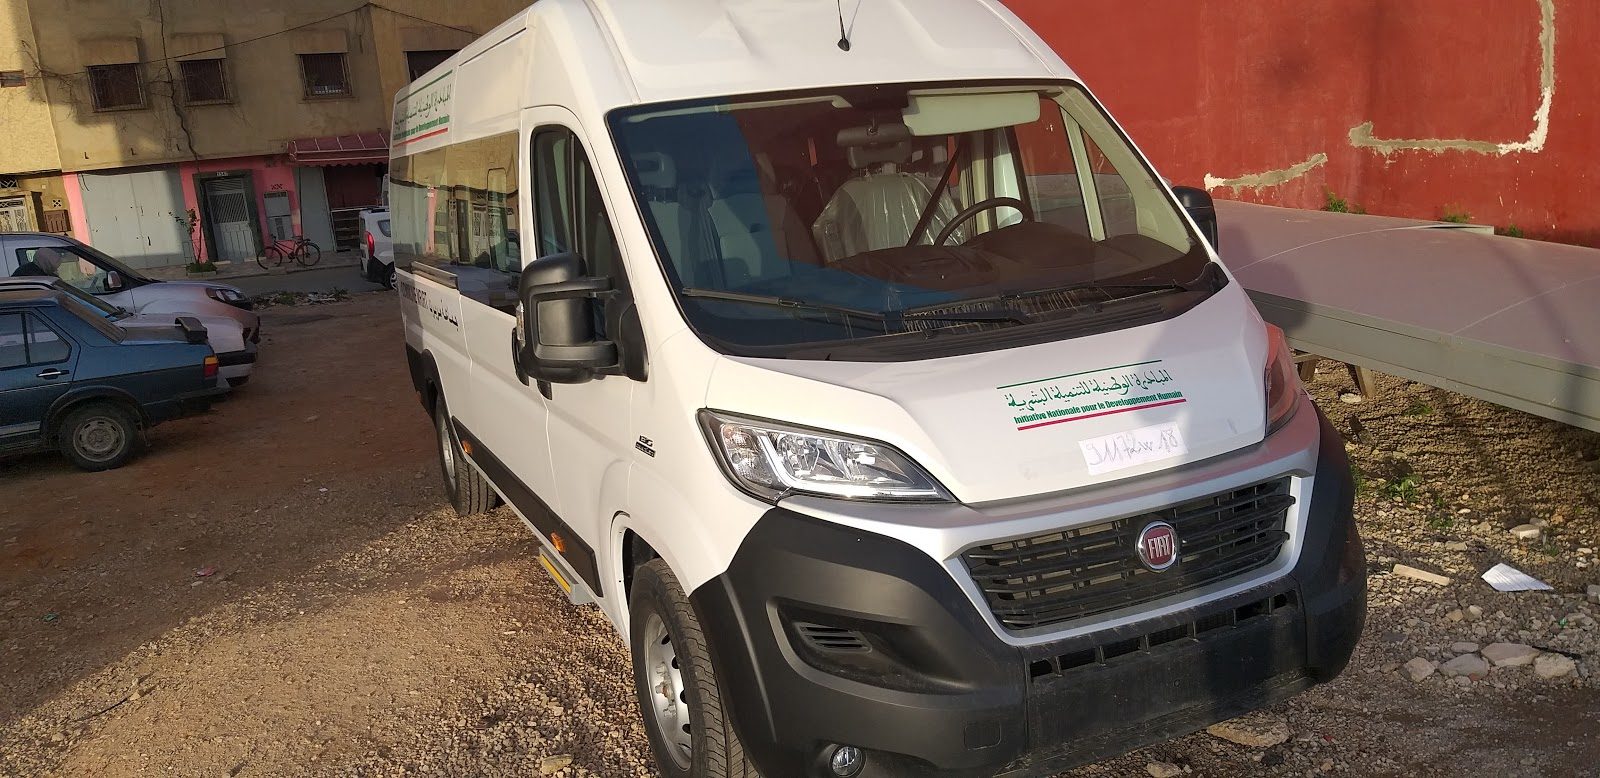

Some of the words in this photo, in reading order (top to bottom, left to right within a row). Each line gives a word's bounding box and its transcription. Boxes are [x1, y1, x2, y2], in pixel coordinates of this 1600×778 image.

[1050, 380, 1091, 402] للتنمية
[1089, 374, 1134, 396] الوطنية
[1129, 369, 1173, 390] المبادرة
[1004, 387, 1053, 411] البشرية
[1014, 412, 1047, 424] Initiative
[1046, 405, 1082, 418] Nationale
[1080, 403, 1098, 413] pour
[1097, 401, 1106, 410] le
[1105, 393, 1159, 409] Developpement
[1157, 390, 1183, 401] Humain
[1147, 533, 1171, 560] FIAT
